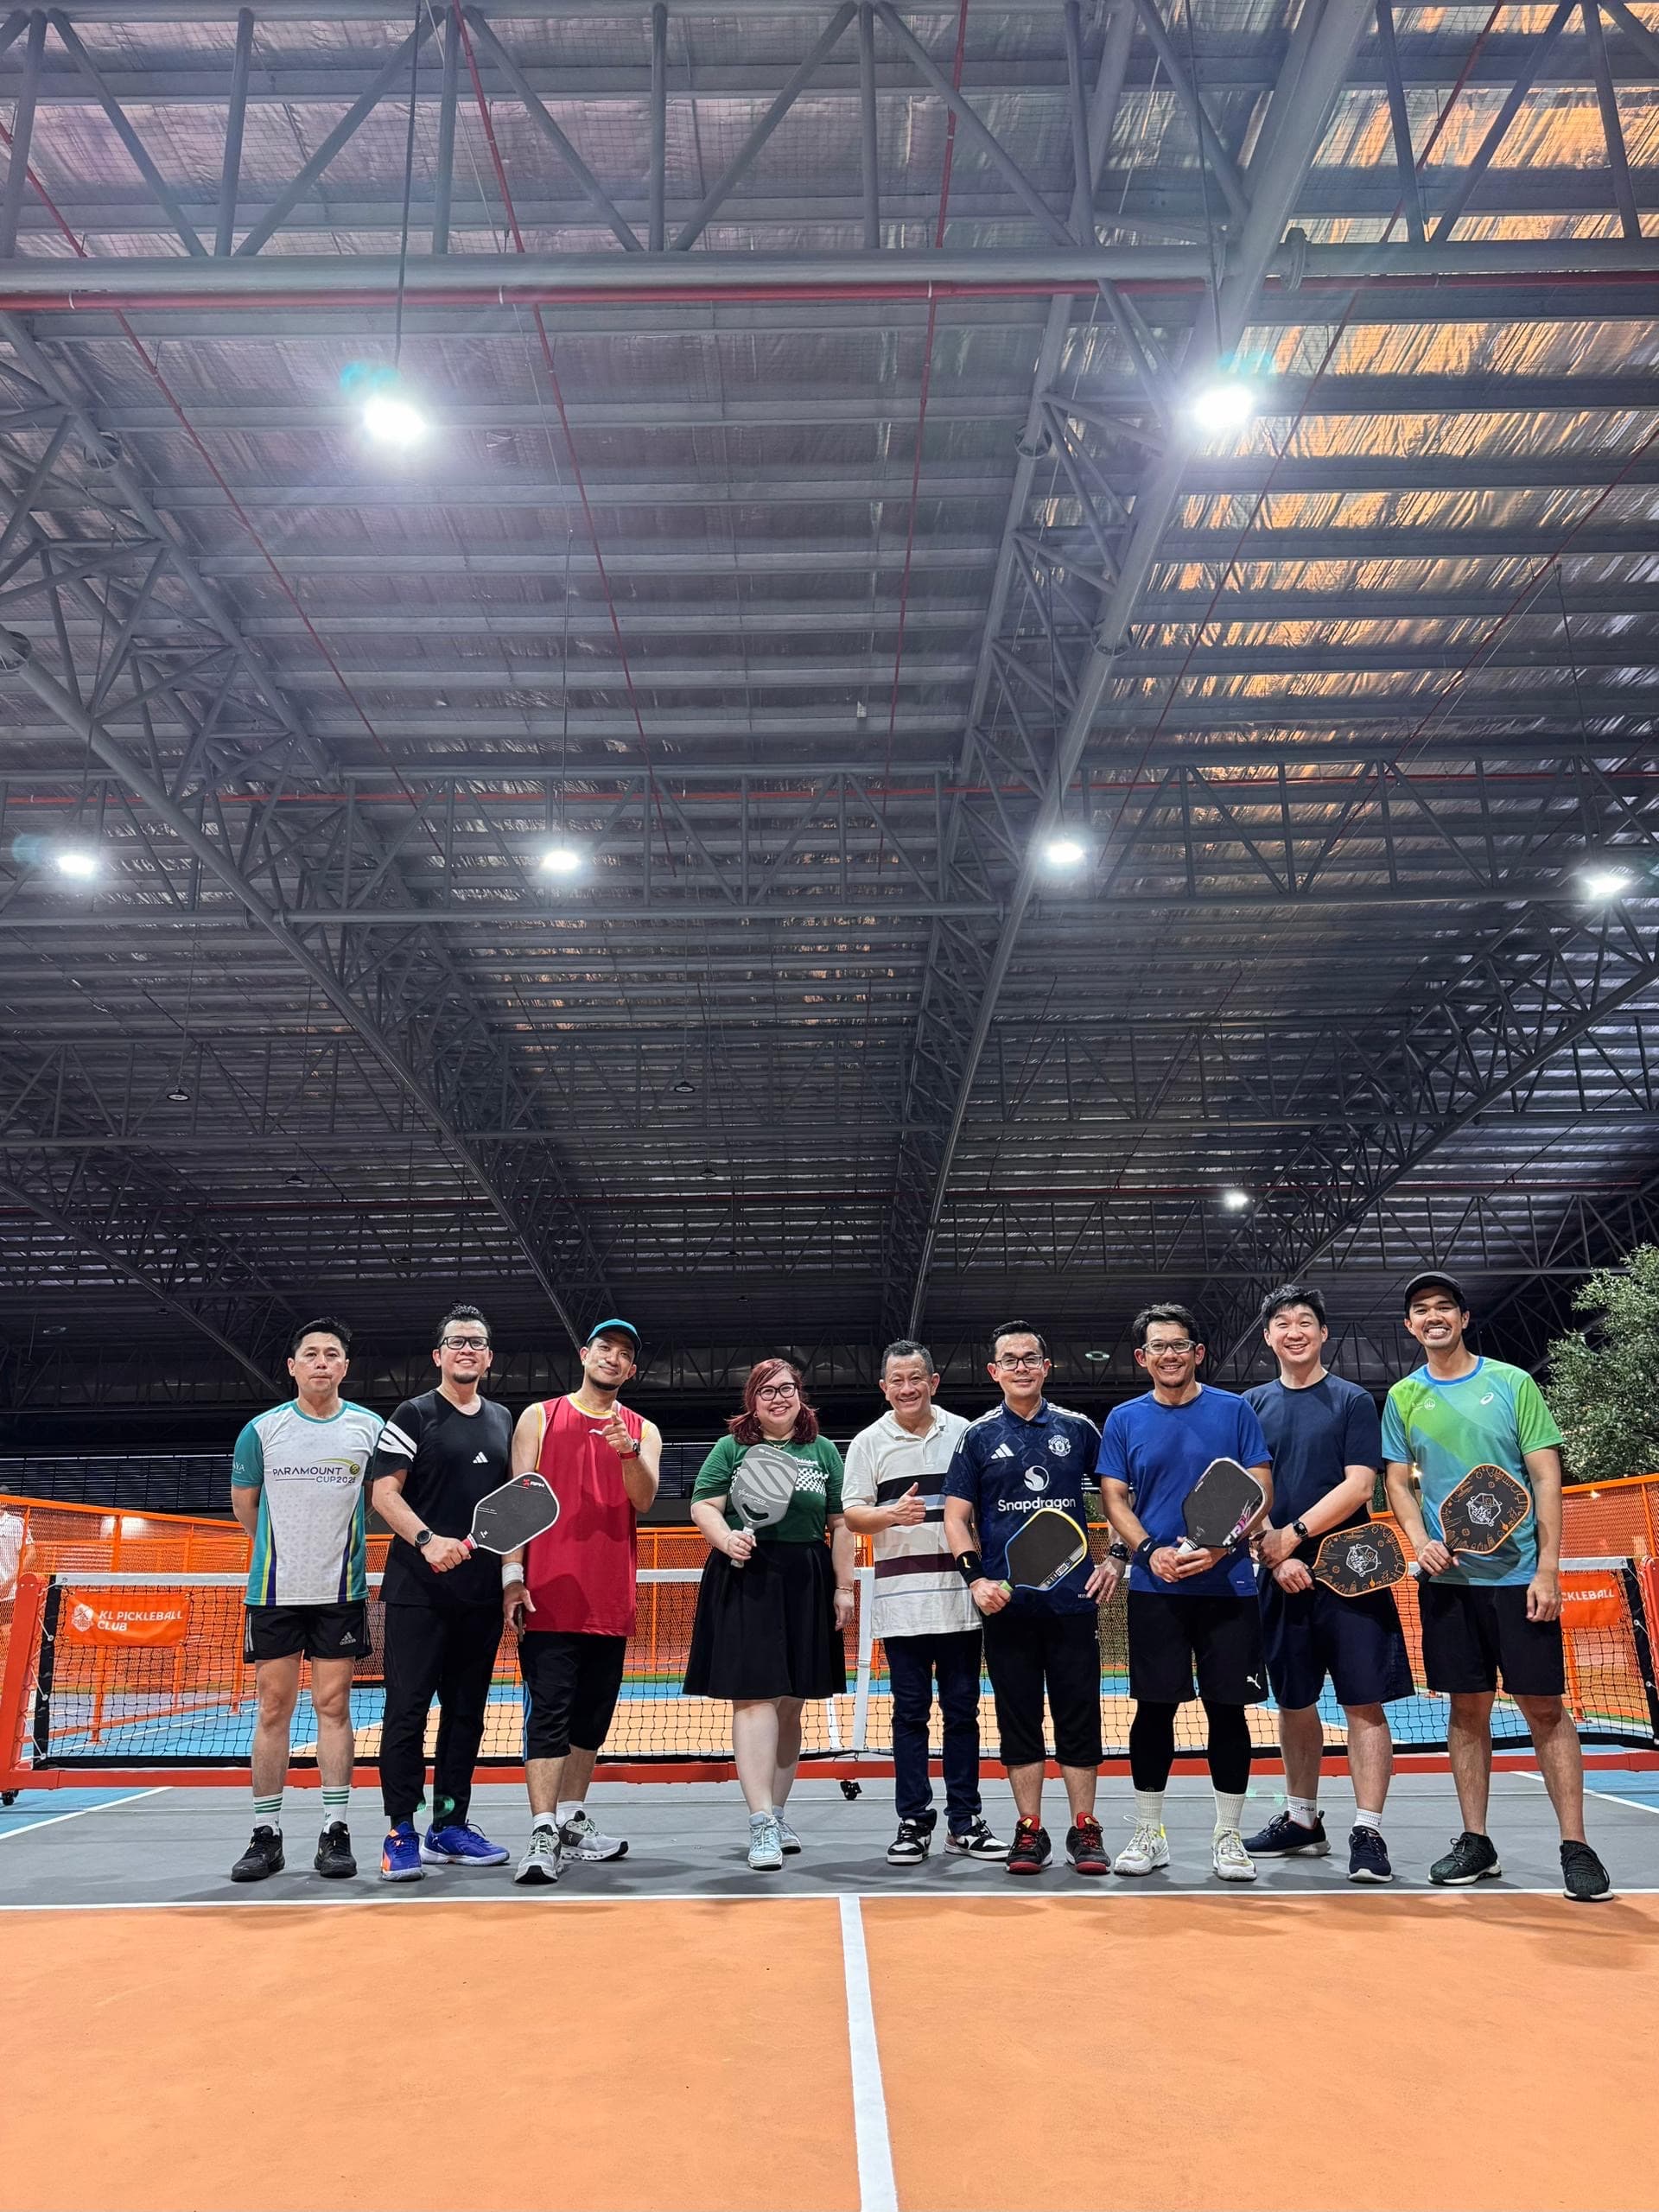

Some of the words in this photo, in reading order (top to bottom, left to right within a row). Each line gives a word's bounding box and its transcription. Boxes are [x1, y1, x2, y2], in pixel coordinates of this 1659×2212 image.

[232, 1461, 245, 1471] YA
[272, 1466, 343, 1476] PARAMOUNT
[997, 1496, 1076, 1513] Snapdragon
[99, 1610, 114, 1620] KL
[116, 1610, 183, 1622] PICKLEBALL
[96, 1620, 127, 1631] CLUB
